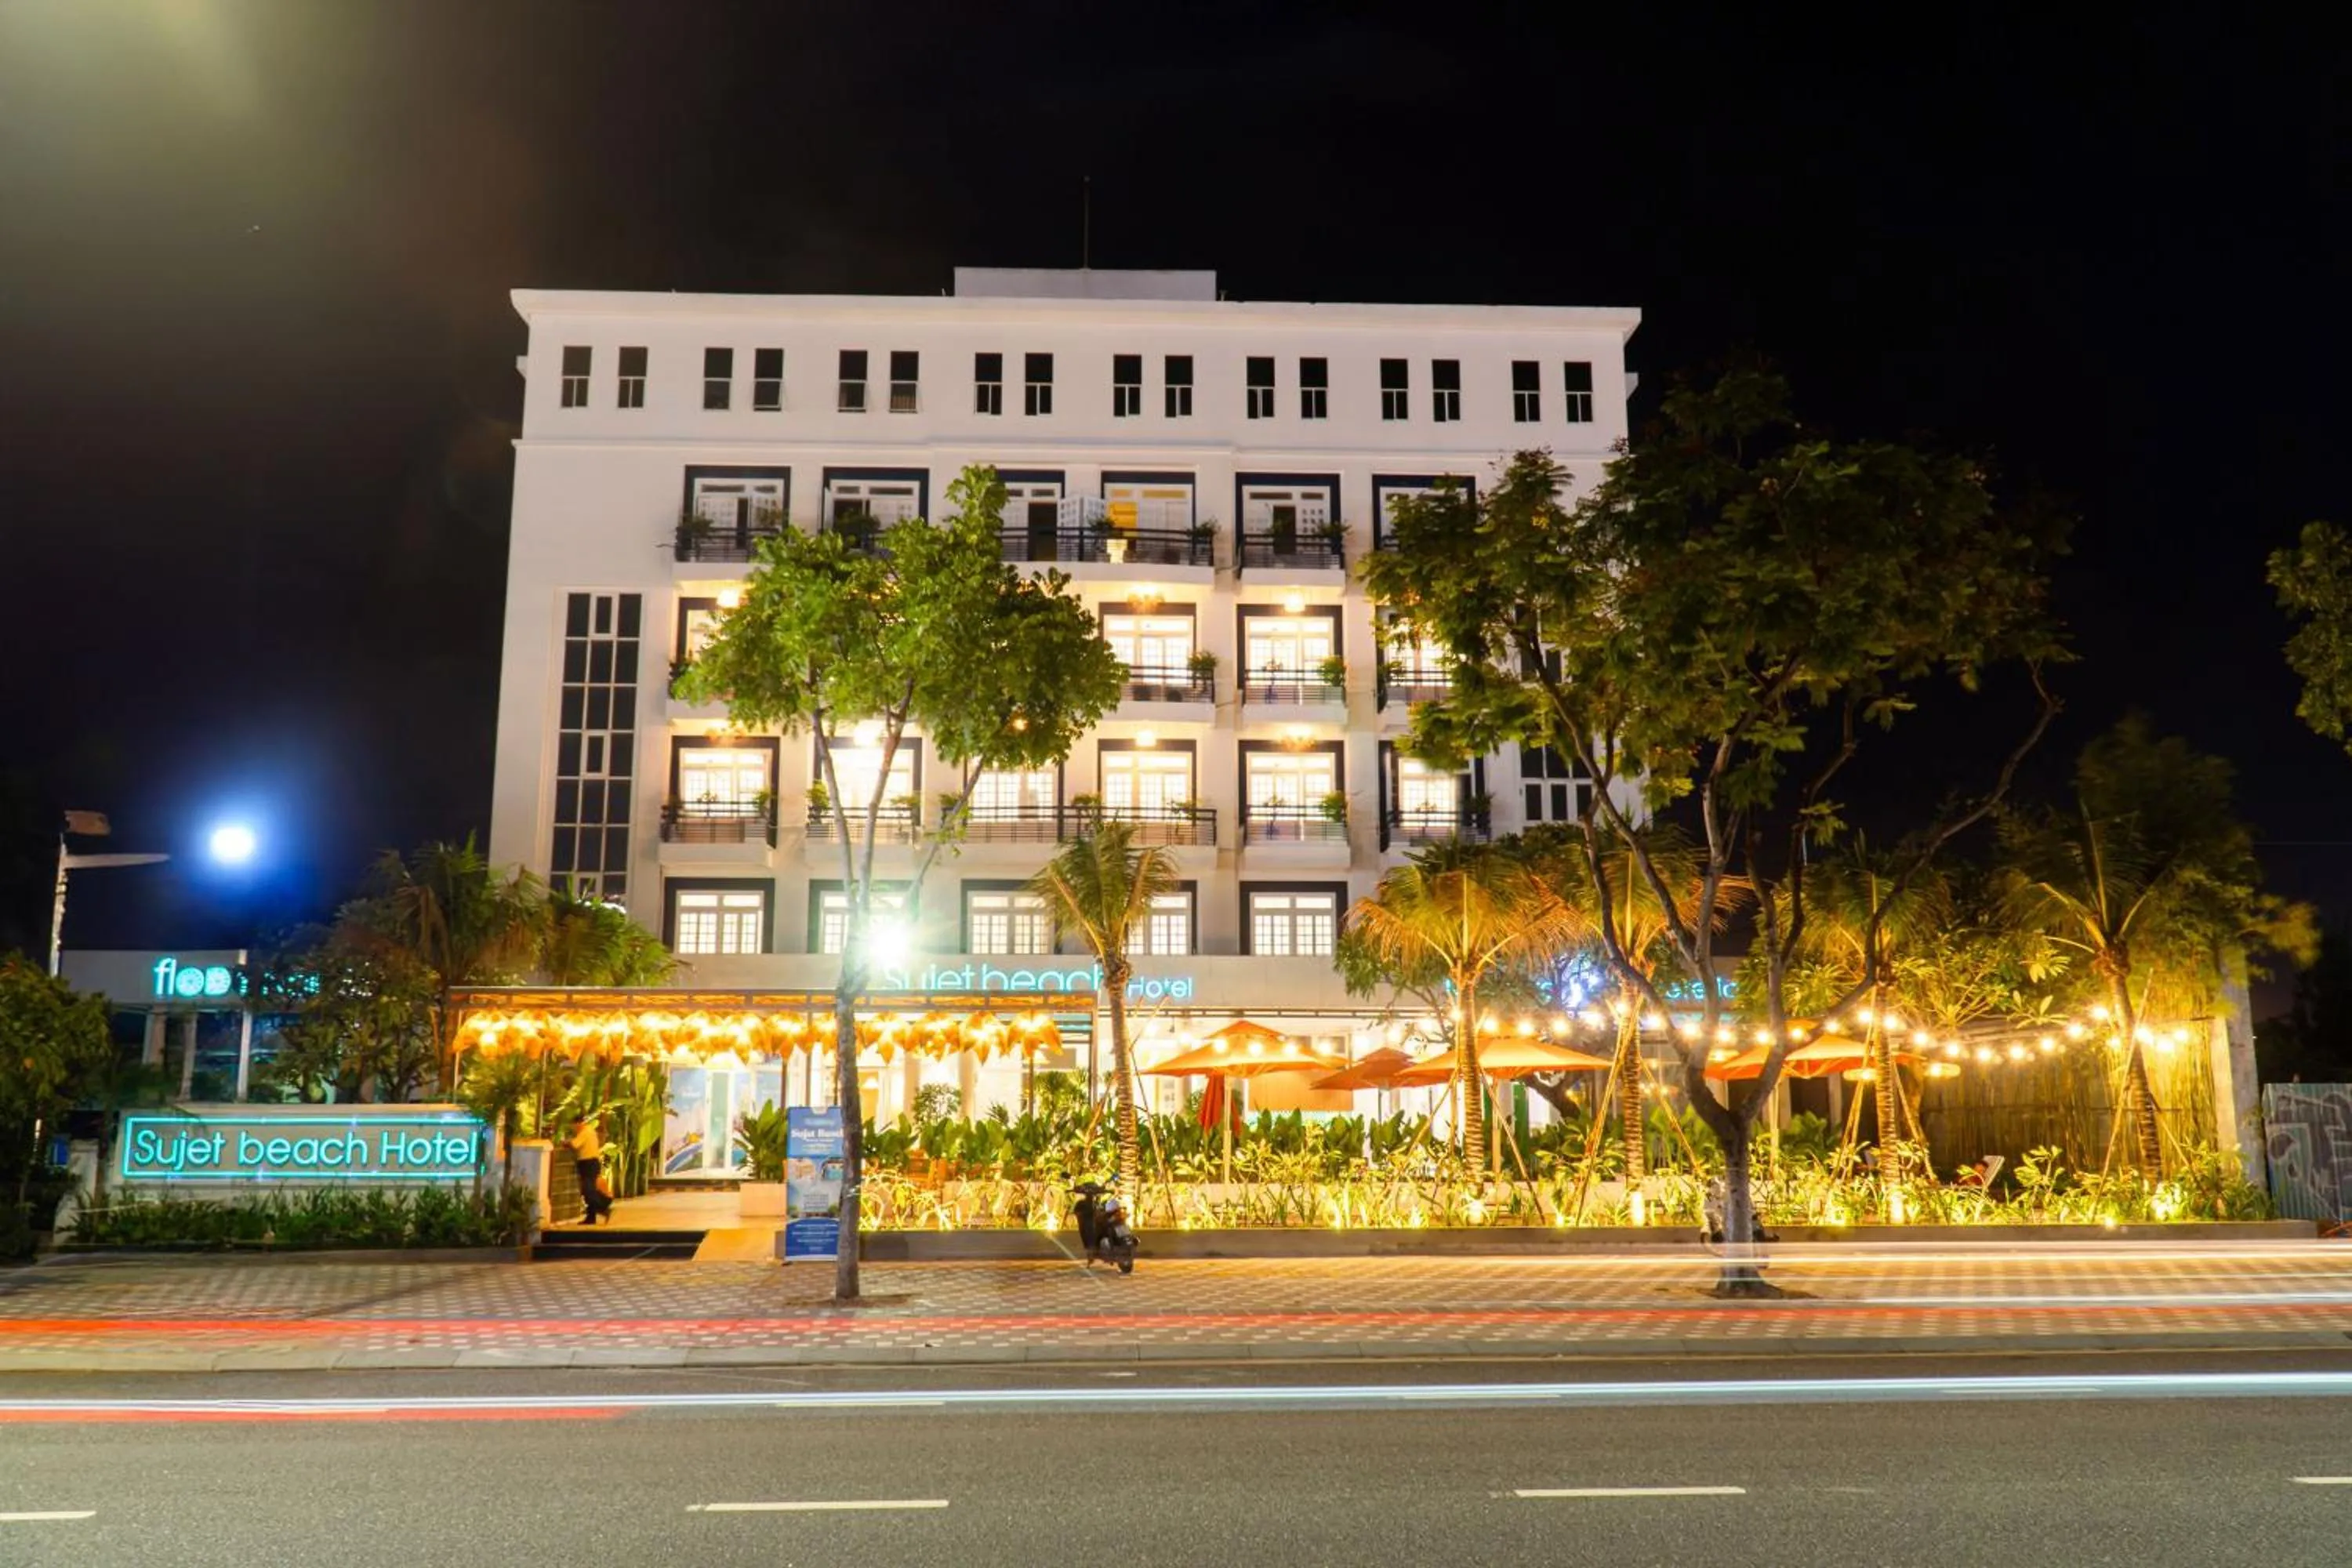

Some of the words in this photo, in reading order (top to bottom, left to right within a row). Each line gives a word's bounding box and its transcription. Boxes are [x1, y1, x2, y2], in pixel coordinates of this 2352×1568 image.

[1127, 976, 1192, 999] Hotel
[133, 1129, 227, 1171] Sujet
[237, 1130, 368, 1166] beach
[379, 1130, 478, 1166] Hotel
